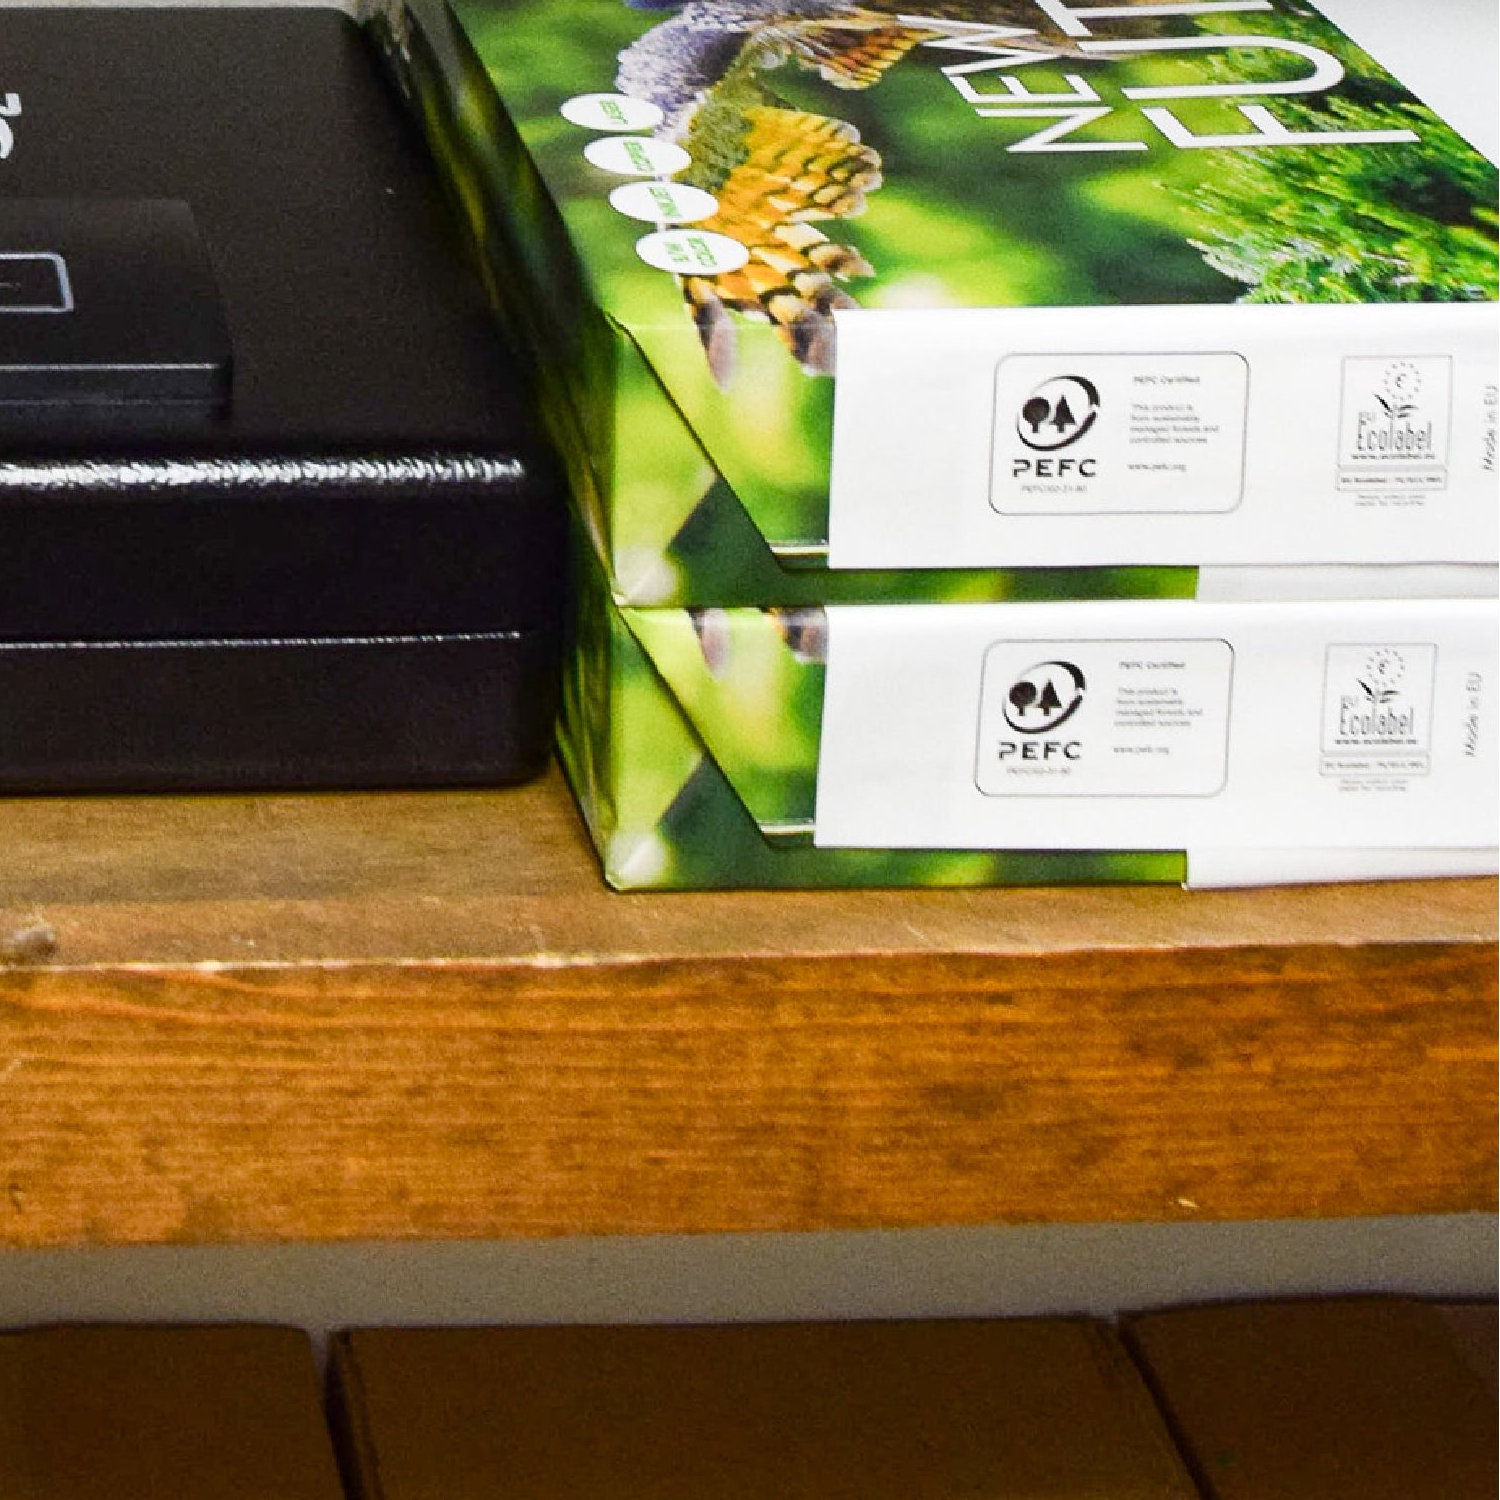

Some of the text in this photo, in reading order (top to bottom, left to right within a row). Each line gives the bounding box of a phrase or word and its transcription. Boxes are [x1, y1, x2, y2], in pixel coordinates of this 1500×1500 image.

[895, 14, 1148, 154] NEW
[1013, 458, 1096, 477] PEFC
[999, 741, 1082, 760] PEFC
